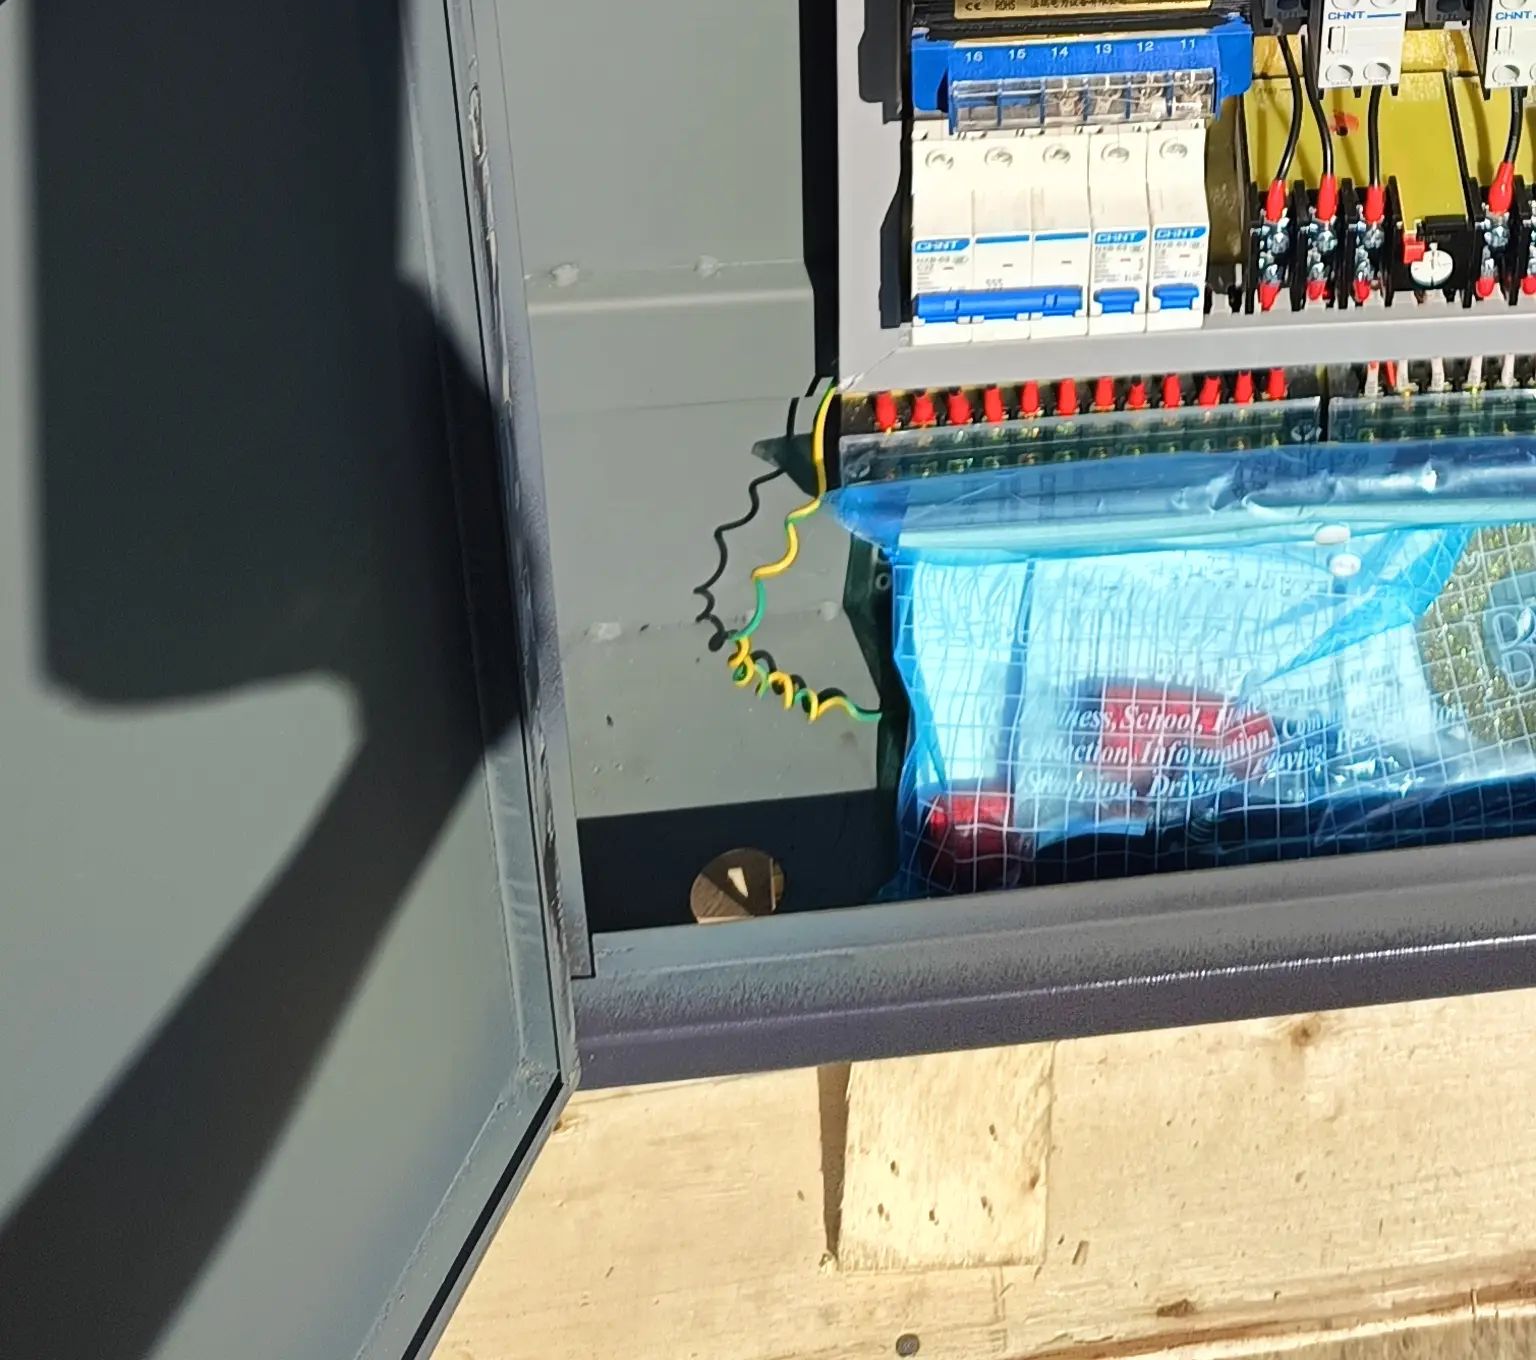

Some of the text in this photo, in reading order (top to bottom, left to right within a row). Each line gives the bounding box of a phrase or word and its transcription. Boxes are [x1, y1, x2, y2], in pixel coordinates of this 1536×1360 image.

[965, 38, 1197, 63] 16 15 14 13 12 11
